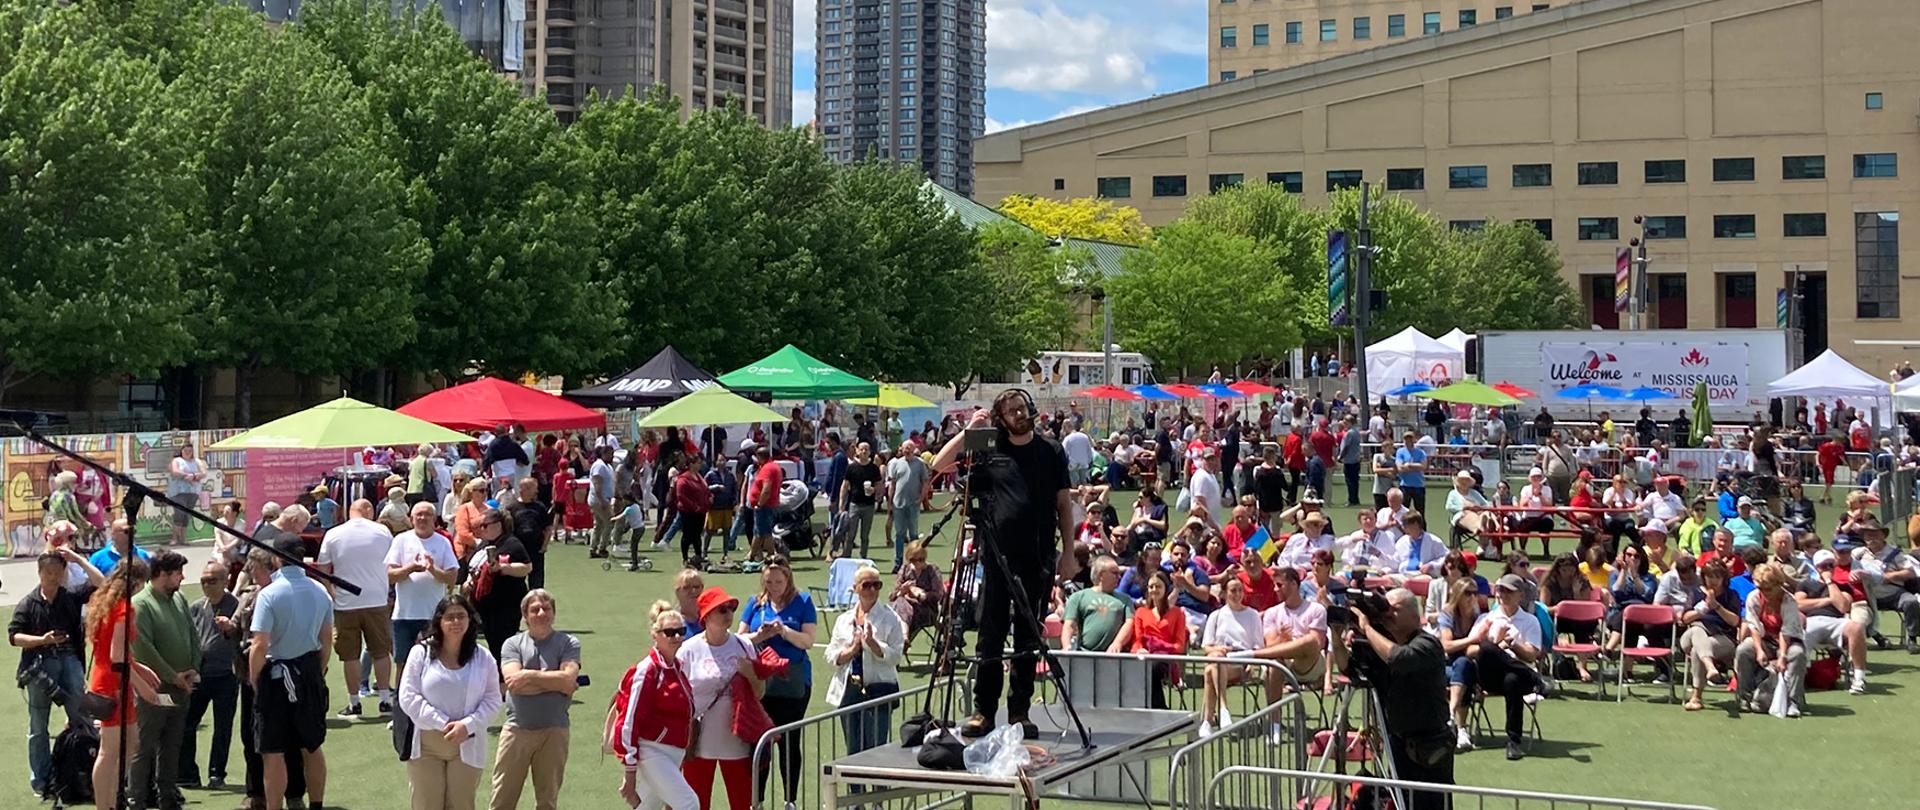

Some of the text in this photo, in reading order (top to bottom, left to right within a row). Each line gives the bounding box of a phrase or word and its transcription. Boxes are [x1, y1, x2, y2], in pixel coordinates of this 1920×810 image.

[1551, 361, 1623, 380] Welcome
[608, 379, 672, 392] MNP
[1652, 374, 1738, 386] MISSISSAUGA
[1709, 388, 1738, 399] DAY
